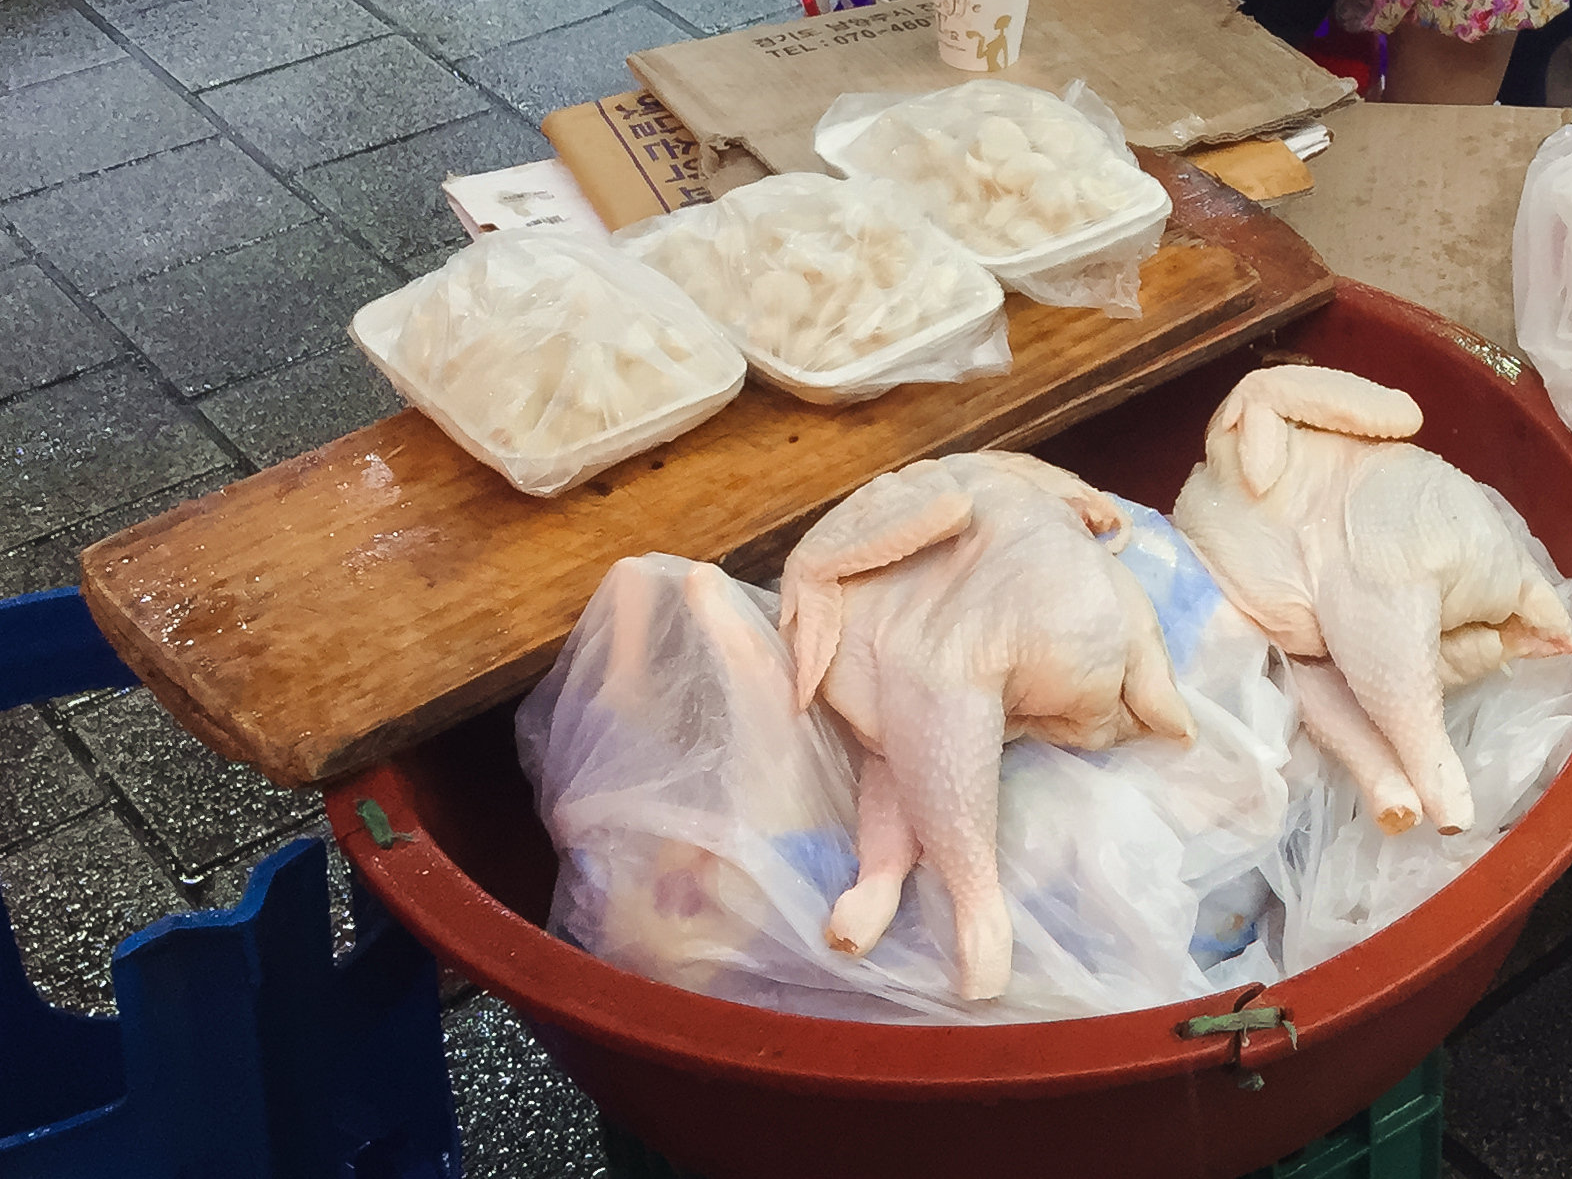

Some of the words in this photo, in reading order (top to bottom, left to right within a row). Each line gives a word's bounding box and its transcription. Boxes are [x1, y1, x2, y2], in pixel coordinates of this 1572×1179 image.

[751, 27, 821, 48] 경기도
[825, 7, 915, 32] 남양주시
[765, 42, 818, 59] TEL
